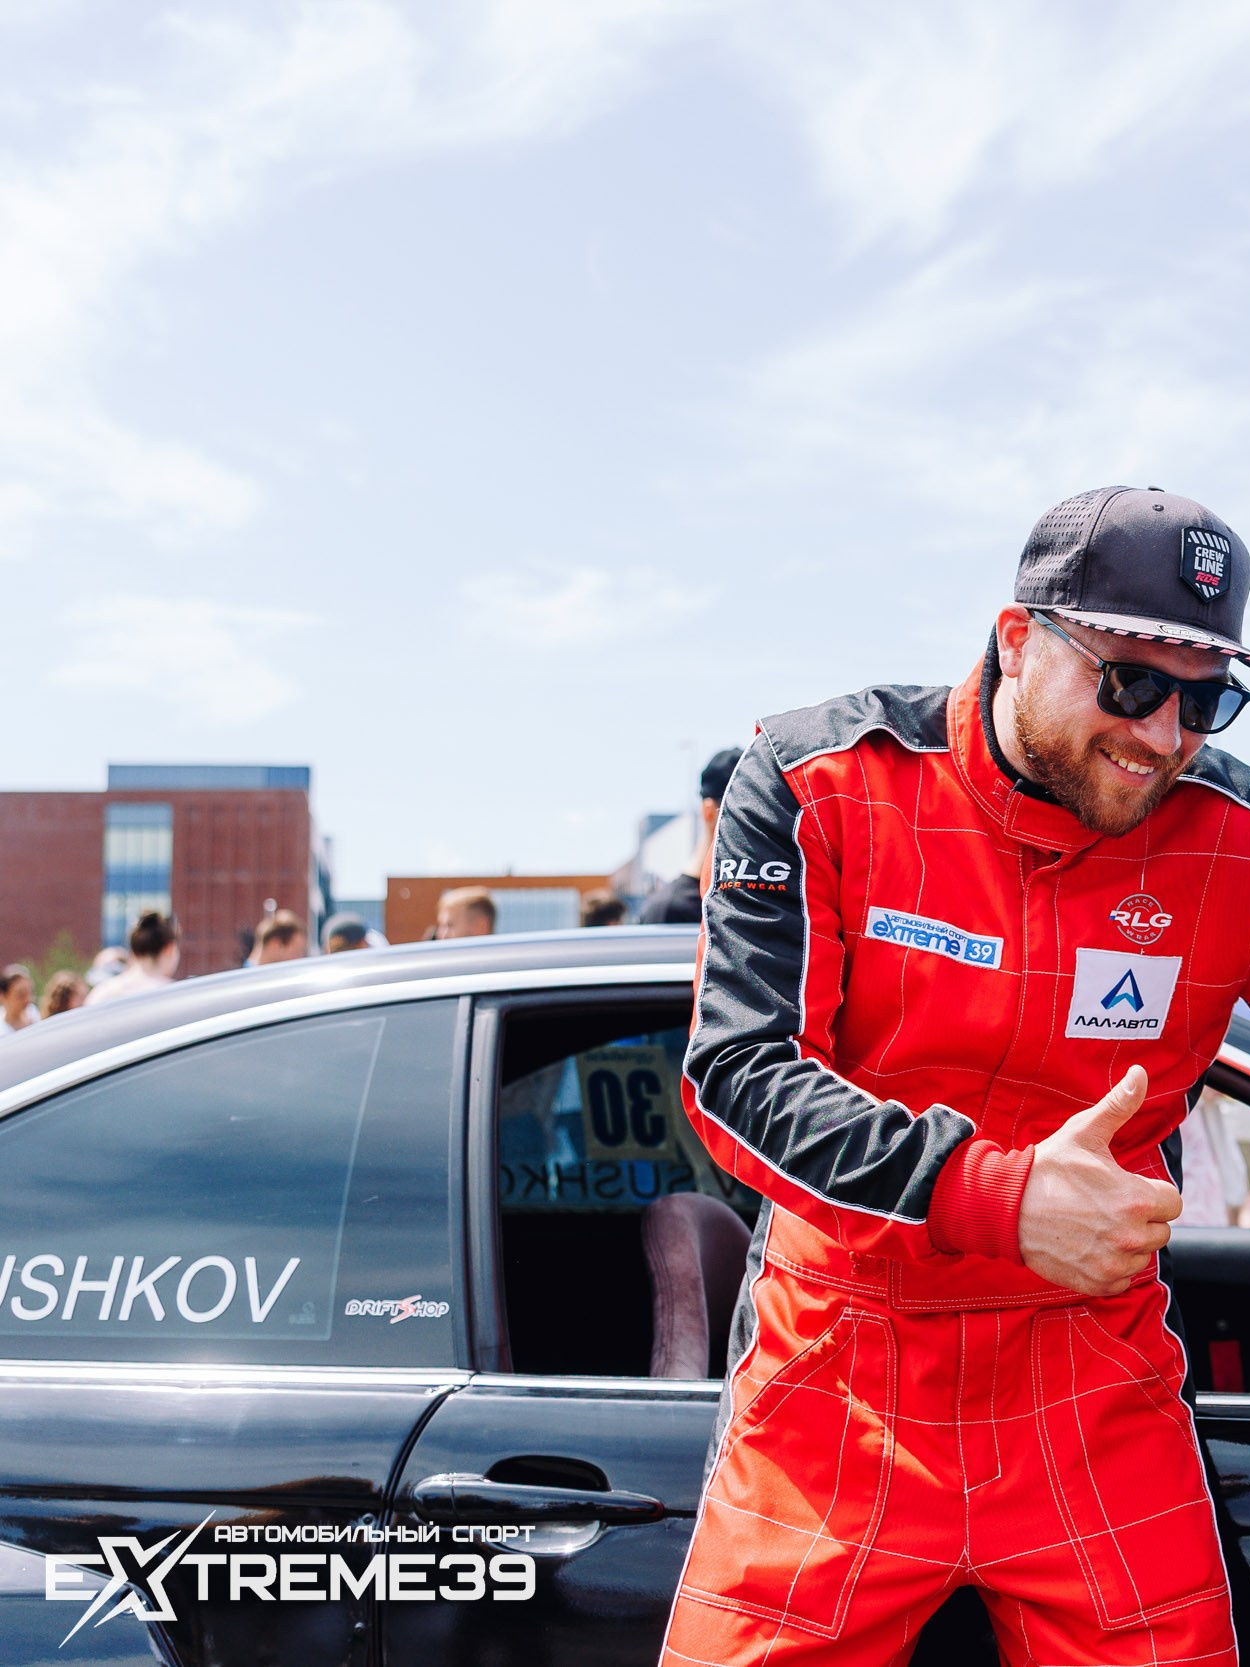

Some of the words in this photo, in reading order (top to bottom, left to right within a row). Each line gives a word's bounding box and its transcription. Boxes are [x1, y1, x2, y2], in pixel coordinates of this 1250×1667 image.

[1195, 546, 1225, 563] CREW
[1194, 556, 1224, 577] LINE
[1195, 571, 1221, 586] RDS
[719, 859, 792, 882] RLG
[747, 882, 787, 891] WEAR
[1109, 910, 1173, 928] RLG
[969, 942, 993, 961] 39
[1074, 1015, 1159, 1029] ЛАЛ-АВТО
